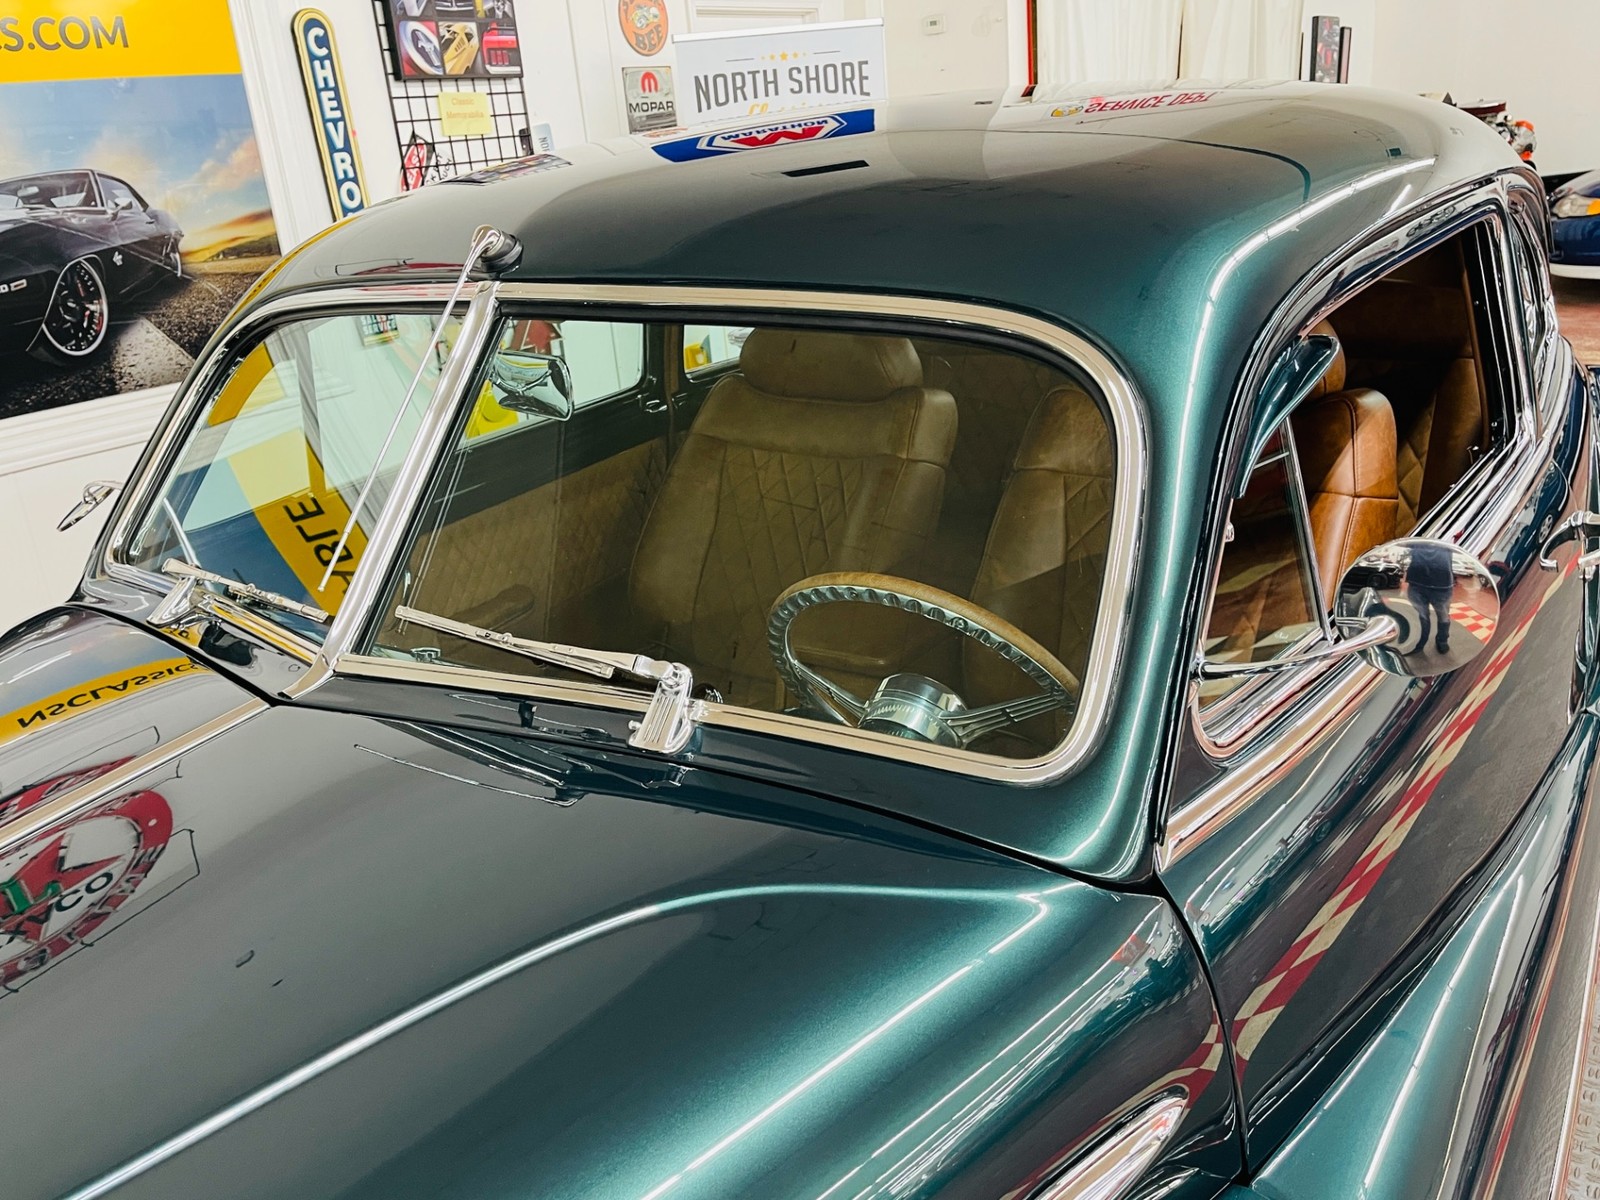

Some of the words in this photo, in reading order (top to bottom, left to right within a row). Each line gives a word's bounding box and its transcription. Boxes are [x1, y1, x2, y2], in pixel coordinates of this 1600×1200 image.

[0, 16, 129, 51] S.COM
[629, 100, 674, 113] MOPAR
[694, 68, 779, 113] NORTH
[788, 60, 871, 97] SHORE
[307, 27, 362, 217] CHEVRO
